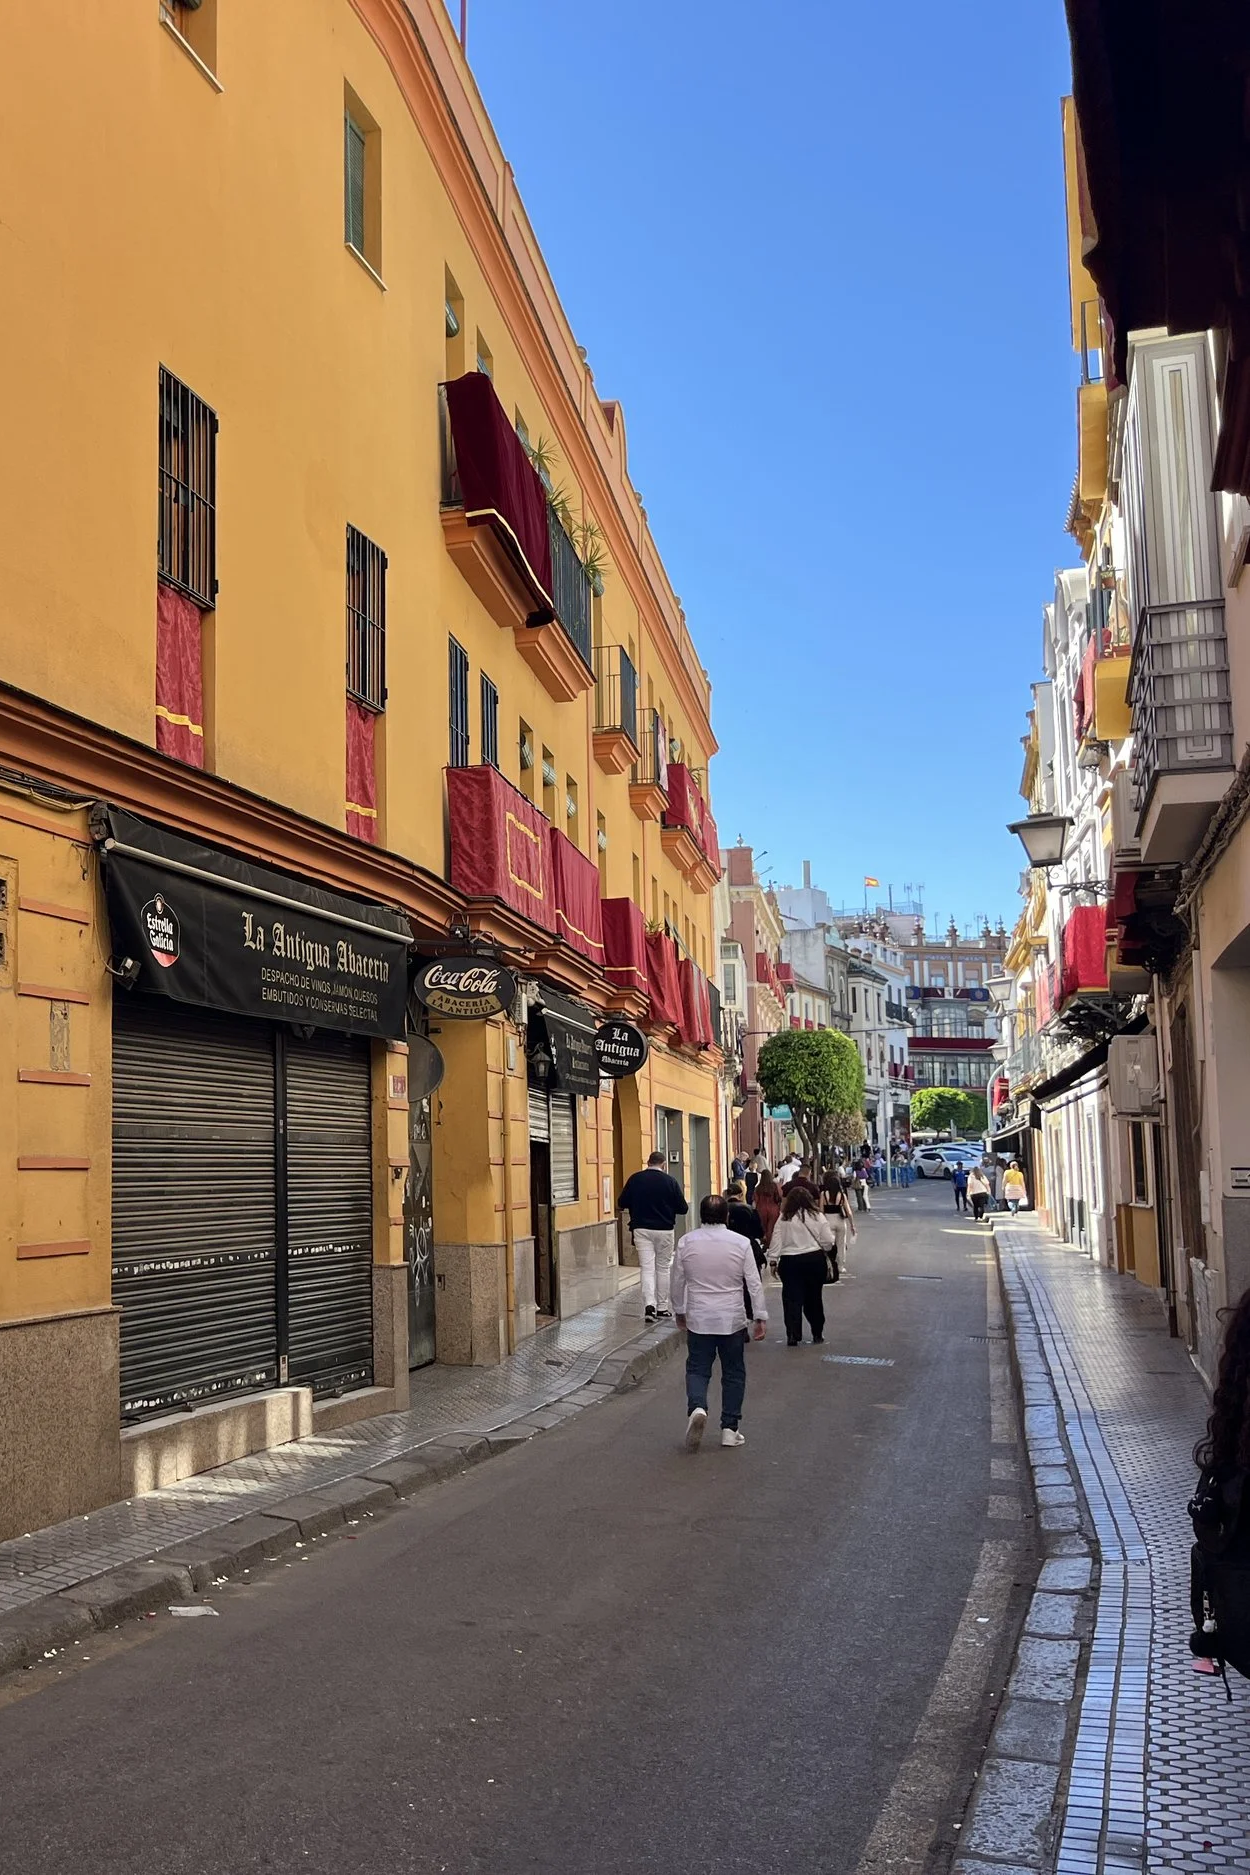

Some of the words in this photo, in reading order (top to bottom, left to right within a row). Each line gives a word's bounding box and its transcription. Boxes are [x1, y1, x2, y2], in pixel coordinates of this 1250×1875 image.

[146, 912, 173, 935] Estrella
[150, 930, 174, 951] Galicia
[241, 911, 265, 951] La
[272, 922, 330, 971] Antigua
[261, 967, 300, 987] DESPACHO
[300, 976, 310, 990] DE
[353, 988, 378, 1005] QUESOS
[262, 987, 303, 1007] EMBUTIDOS
[304, 996, 310, 1008] Y
[310, 996, 348, 1016] CONSERVAS
[432, 999, 444, 1009] LA
[447, 1004, 496, 1015] ANTIGUA
[437, 994, 491, 1008] ABACERÍA
[611, 1027, 629, 1042] La
[594, 1038, 640, 1058] Antigua
